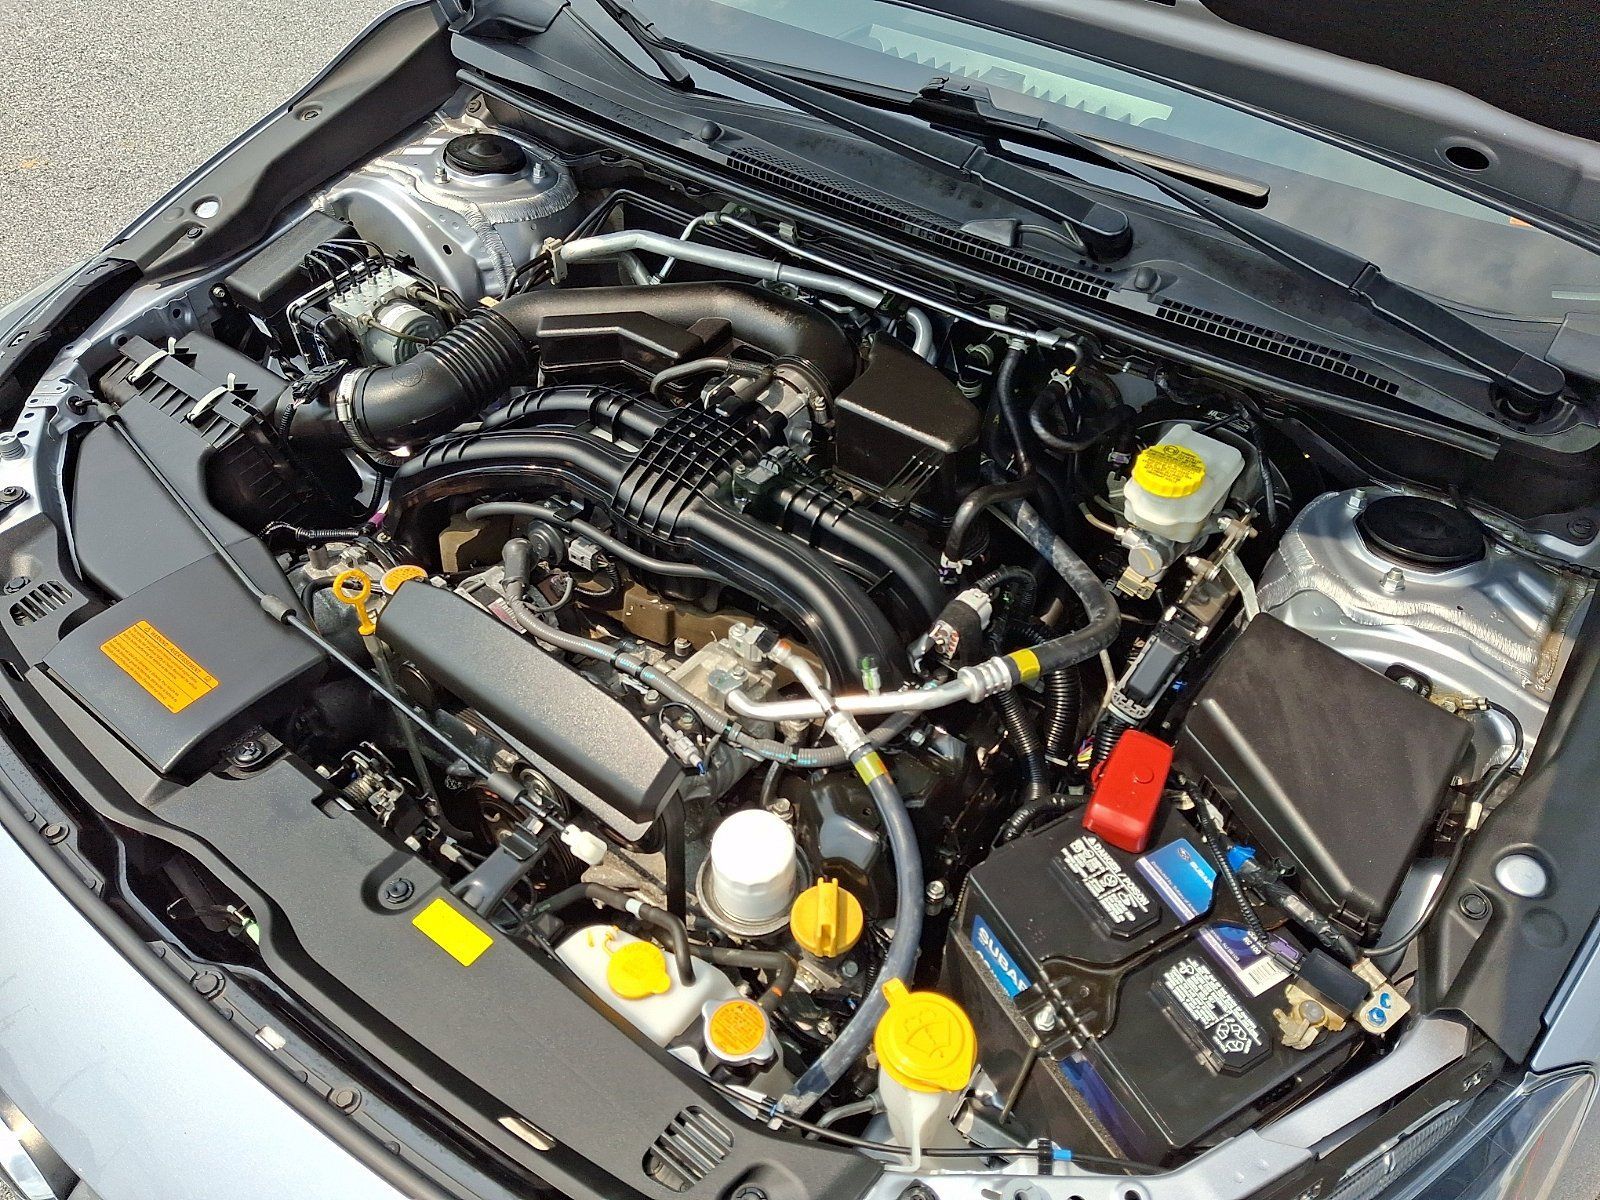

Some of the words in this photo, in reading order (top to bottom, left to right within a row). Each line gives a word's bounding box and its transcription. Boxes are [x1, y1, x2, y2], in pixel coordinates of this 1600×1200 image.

[1092, 841, 1122, 874] DANGER
[1117, 870, 1126, 880] /
[1188, 860, 1215, 889] SUBAR
[1121, 876, 1149, 906] POISON
[978, 927, 1028, 992] SUBAR
